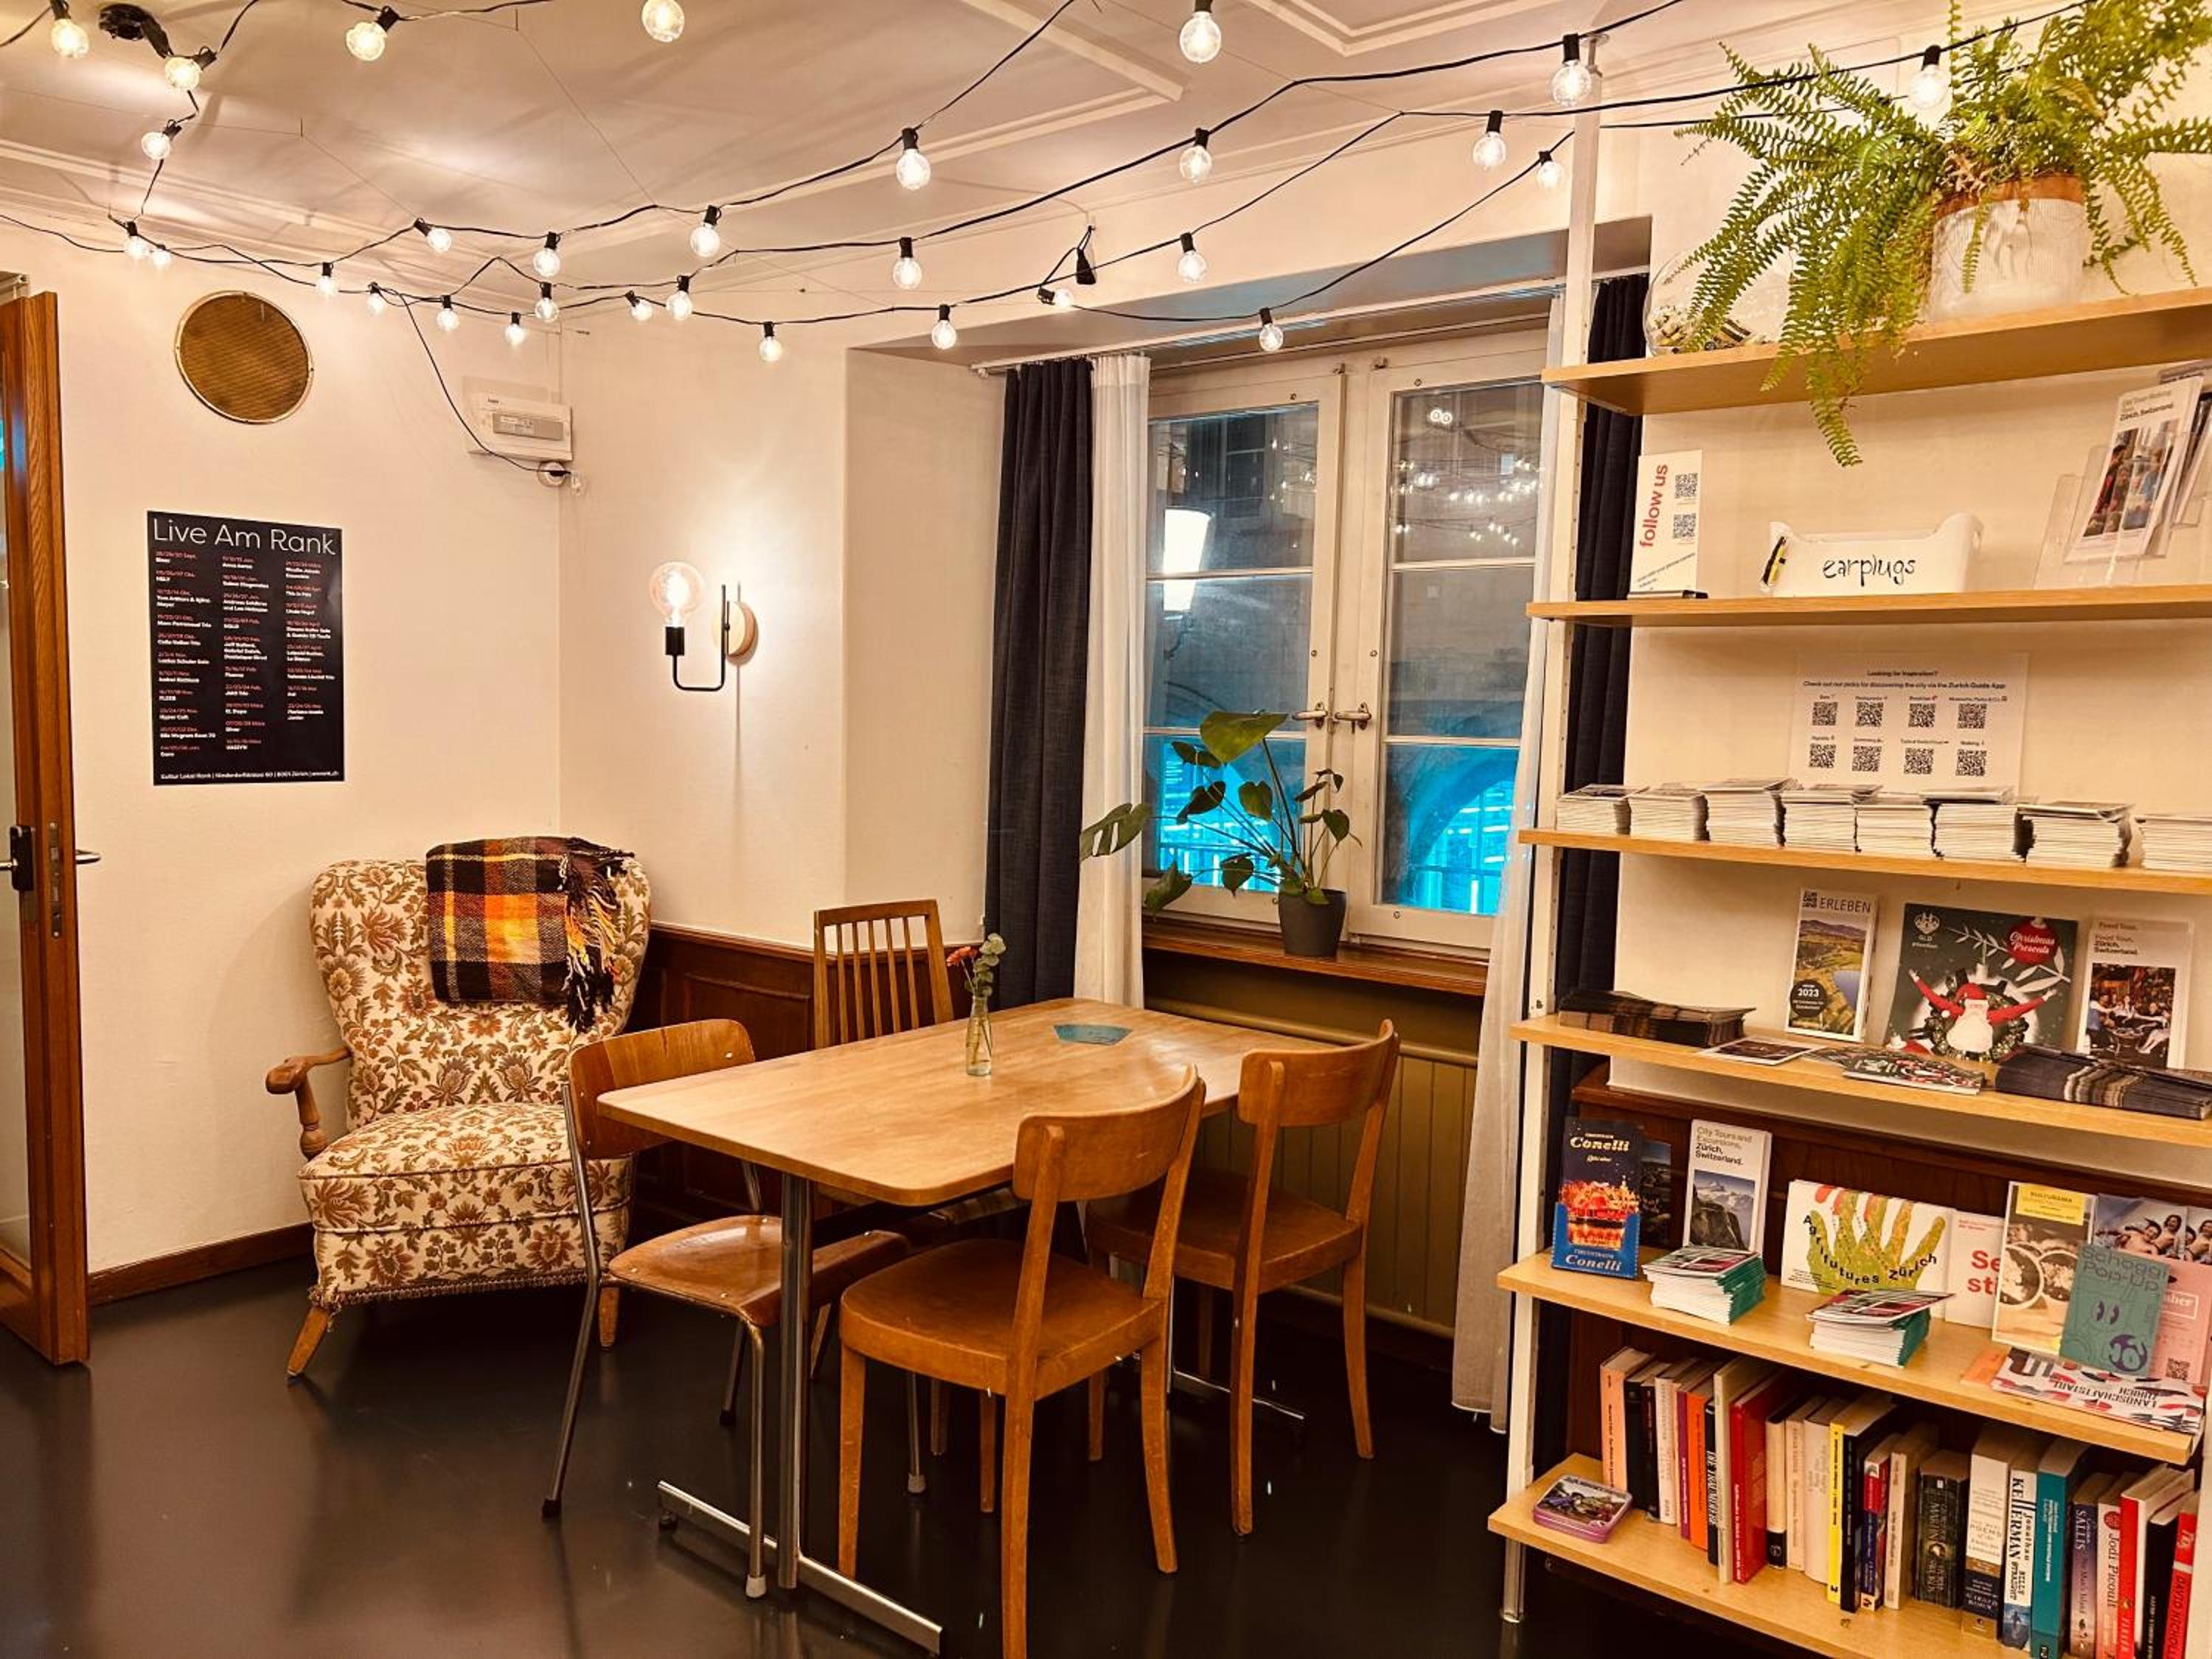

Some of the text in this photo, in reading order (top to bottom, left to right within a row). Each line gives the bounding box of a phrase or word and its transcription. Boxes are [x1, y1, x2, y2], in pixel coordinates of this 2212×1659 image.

[1639, 465, 1669, 547] follow us
[153, 518, 336, 555] Live Am Rank
[1823, 554, 1916, 586] earplugs
[1819, 897, 1871, 913] ERLEBEN
[2009, 931, 2055, 945] Christmas
[2013, 941, 2050, 954] Presents
[1797, 988, 1820, 998] 2023
[1570, 1136, 1631, 1152] Conelli
[1697, 1126, 1753, 1143] City Tours and
[1695, 1150, 1744, 1166] Switzerland.
[1696, 1143, 1723, 1155] Zürich,
[1803, 1215, 1879, 1284] Agrifutures
[1888, 1253, 1937, 1281] Zürich
[1565, 1254, 1621, 1273] Conelli
[2023, 1512, 2032, 1561] Jonathan
[2075, 1509, 2086, 1551] SALLIS
[2107, 1533, 2121, 1608] Jodi Picoult
[2174, 1576, 2187, 1613] DAVID
